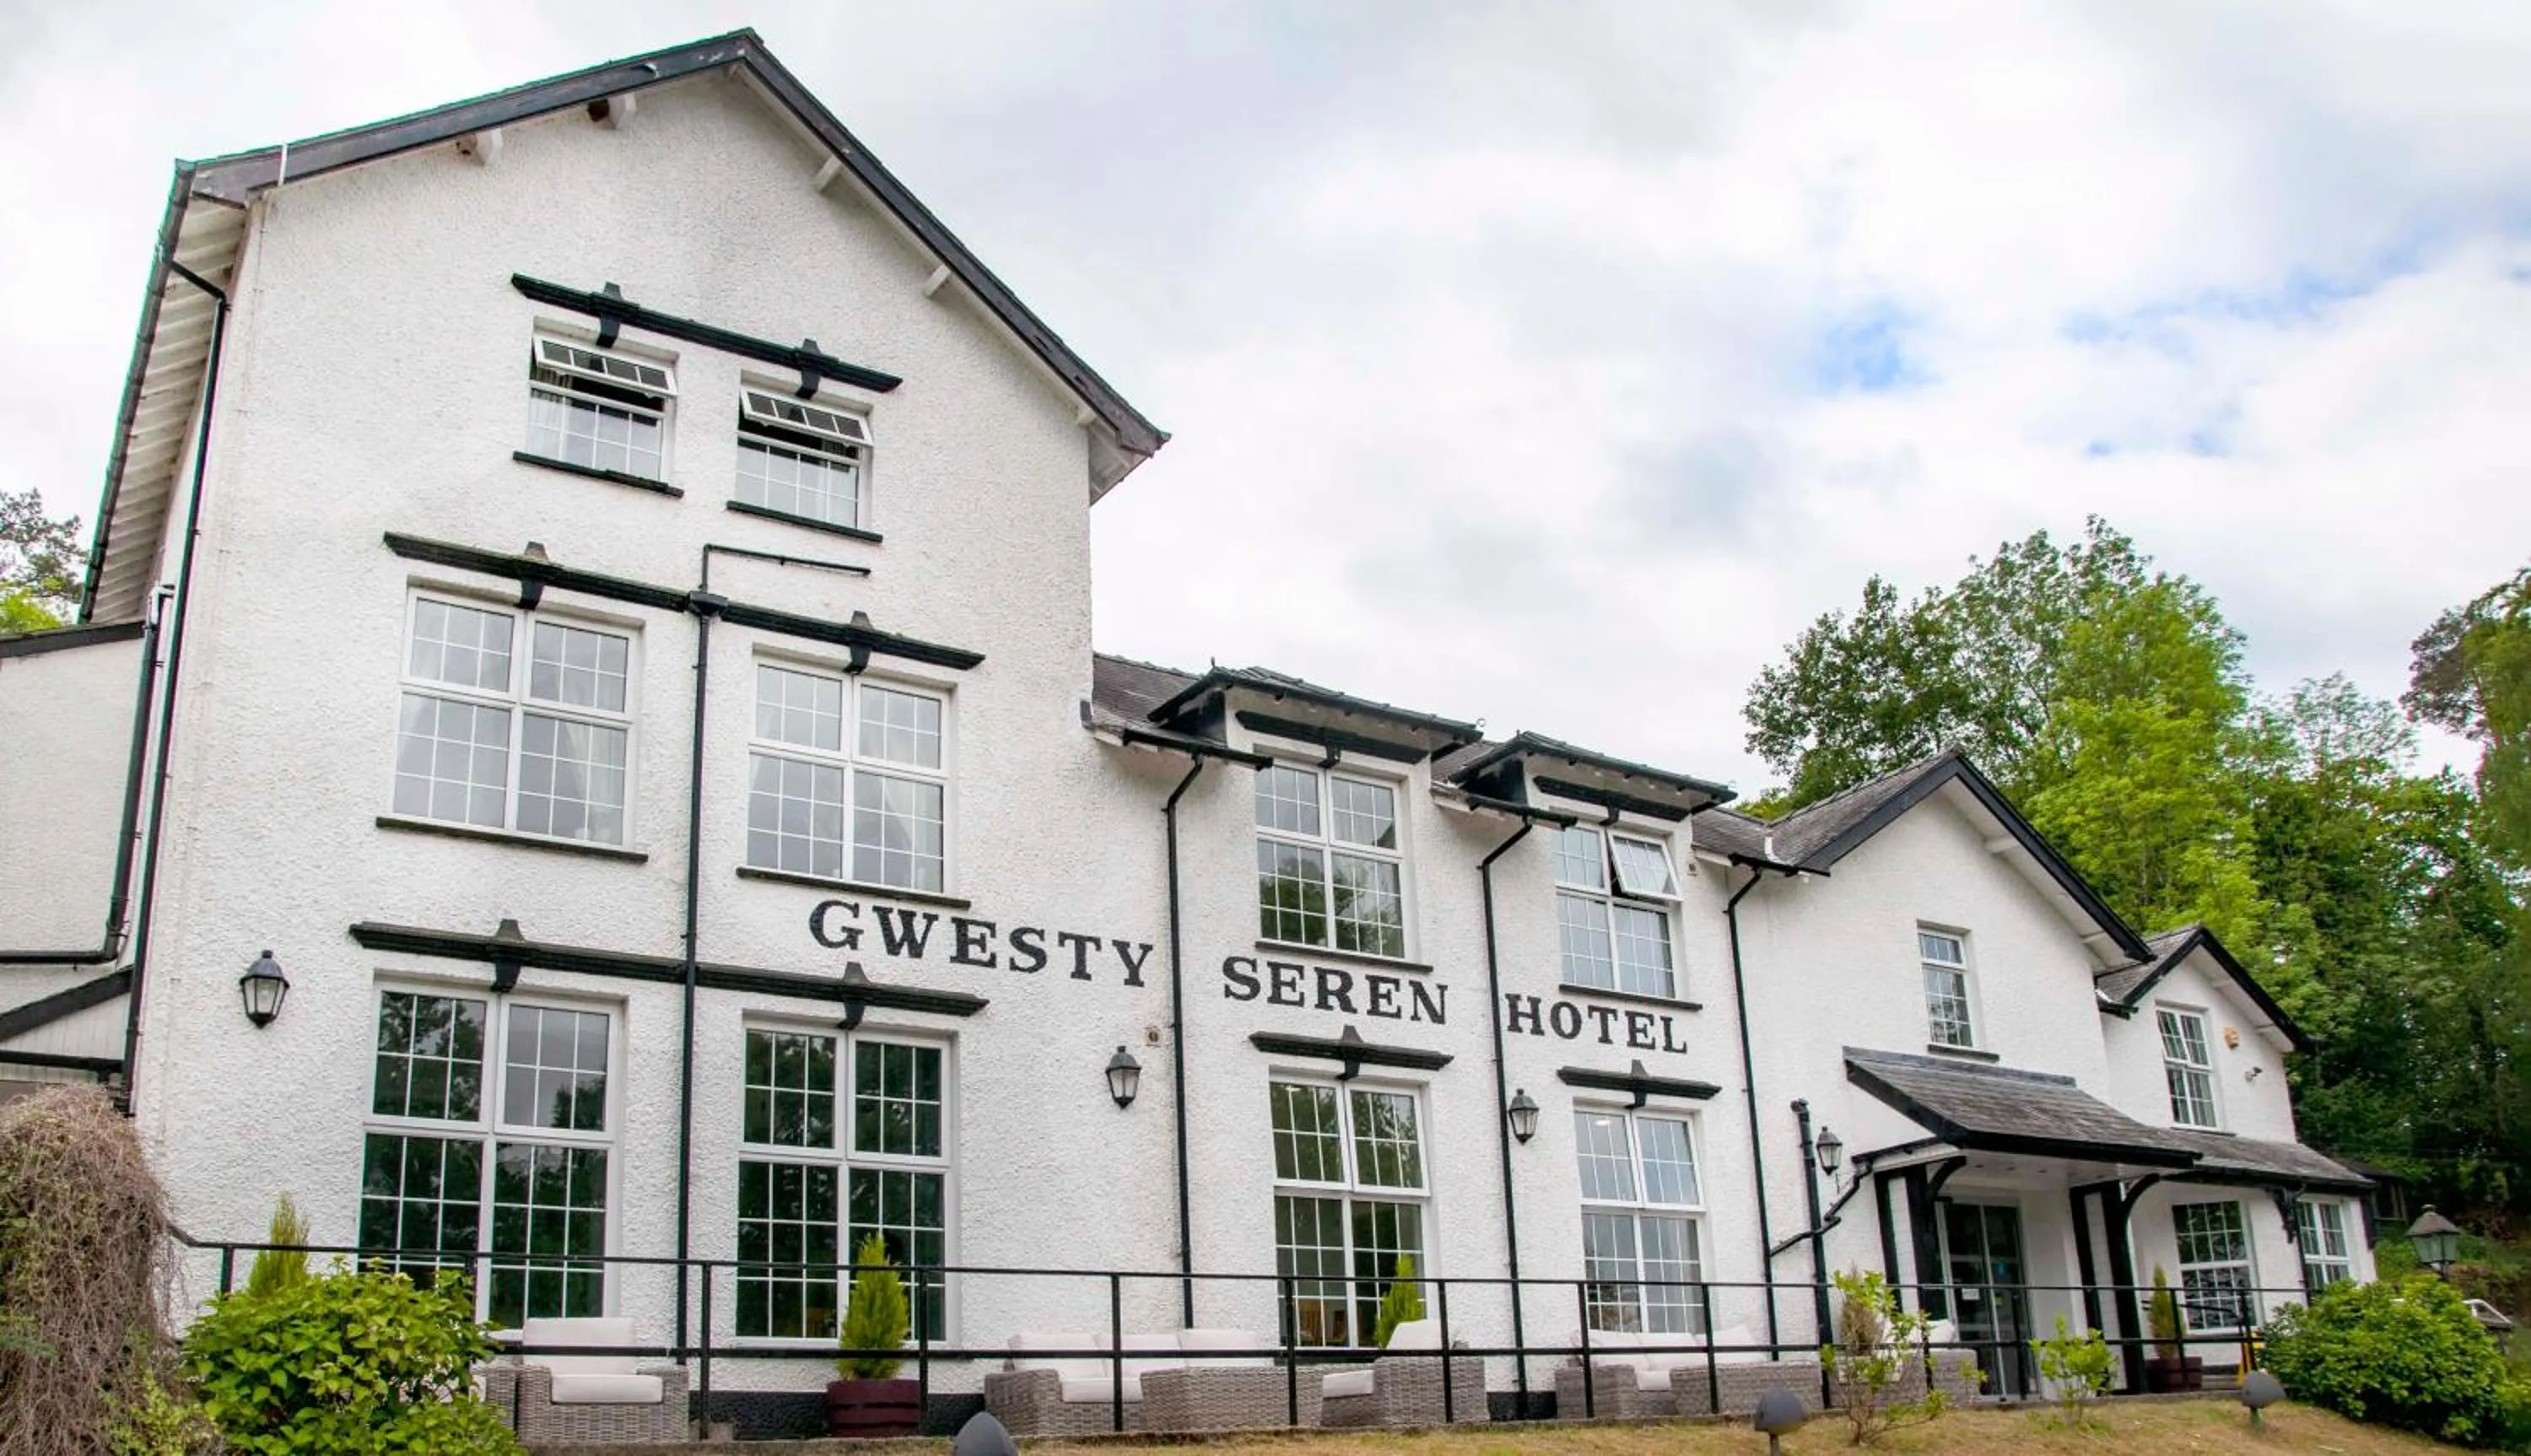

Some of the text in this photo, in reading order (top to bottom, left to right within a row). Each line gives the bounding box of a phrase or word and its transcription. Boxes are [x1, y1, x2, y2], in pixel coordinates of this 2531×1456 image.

[808, 899, 1687, 1054] GWESTY SEREN HOTEL
